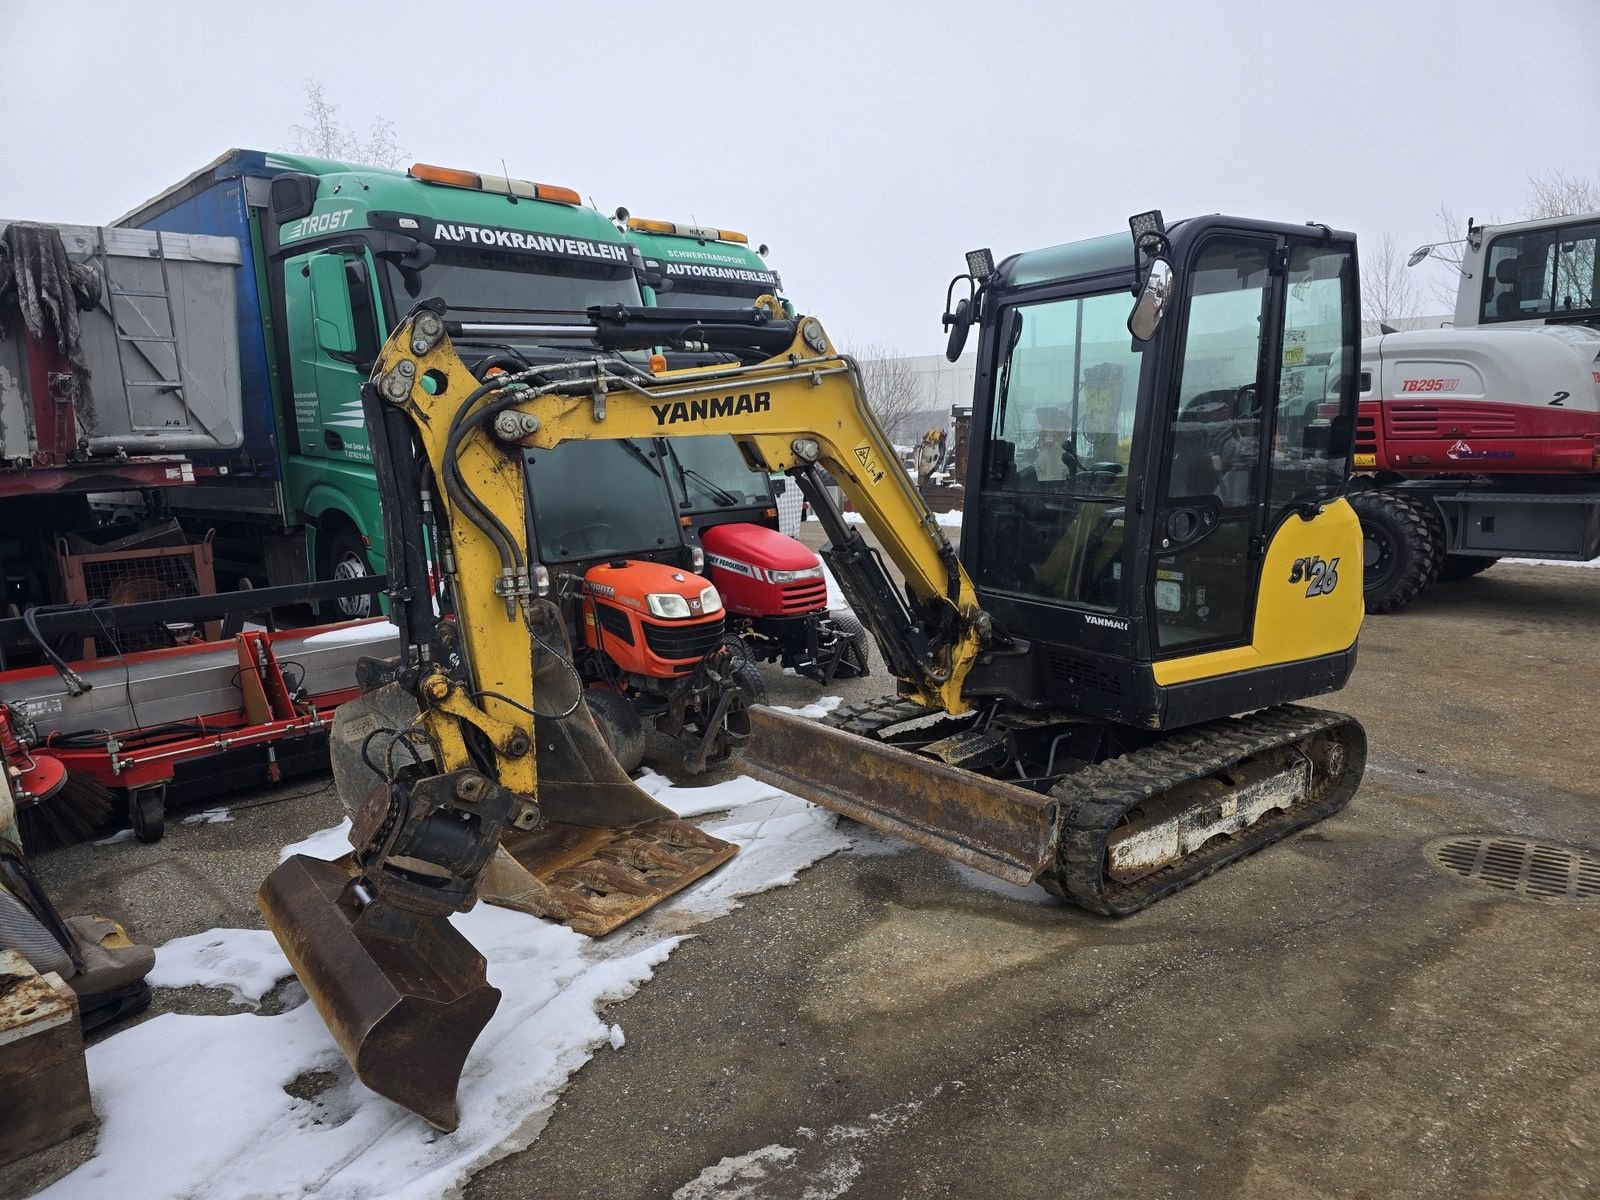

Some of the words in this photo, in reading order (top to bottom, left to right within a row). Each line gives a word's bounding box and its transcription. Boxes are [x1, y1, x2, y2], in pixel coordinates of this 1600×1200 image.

[300, 209, 353, 236] TROST
[434, 223, 628, 262] AUTOKRANVERLEIH
[667, 250, 747, 265] SCHWERTRANSPORT
[666, 263, 776, 284] AUTOKRANVERLEIH
[651, 391, 770, 426] YANMAR
[1548, 391, 1570, 406] 2
[719, 558, 749, 573] FERGUSON
